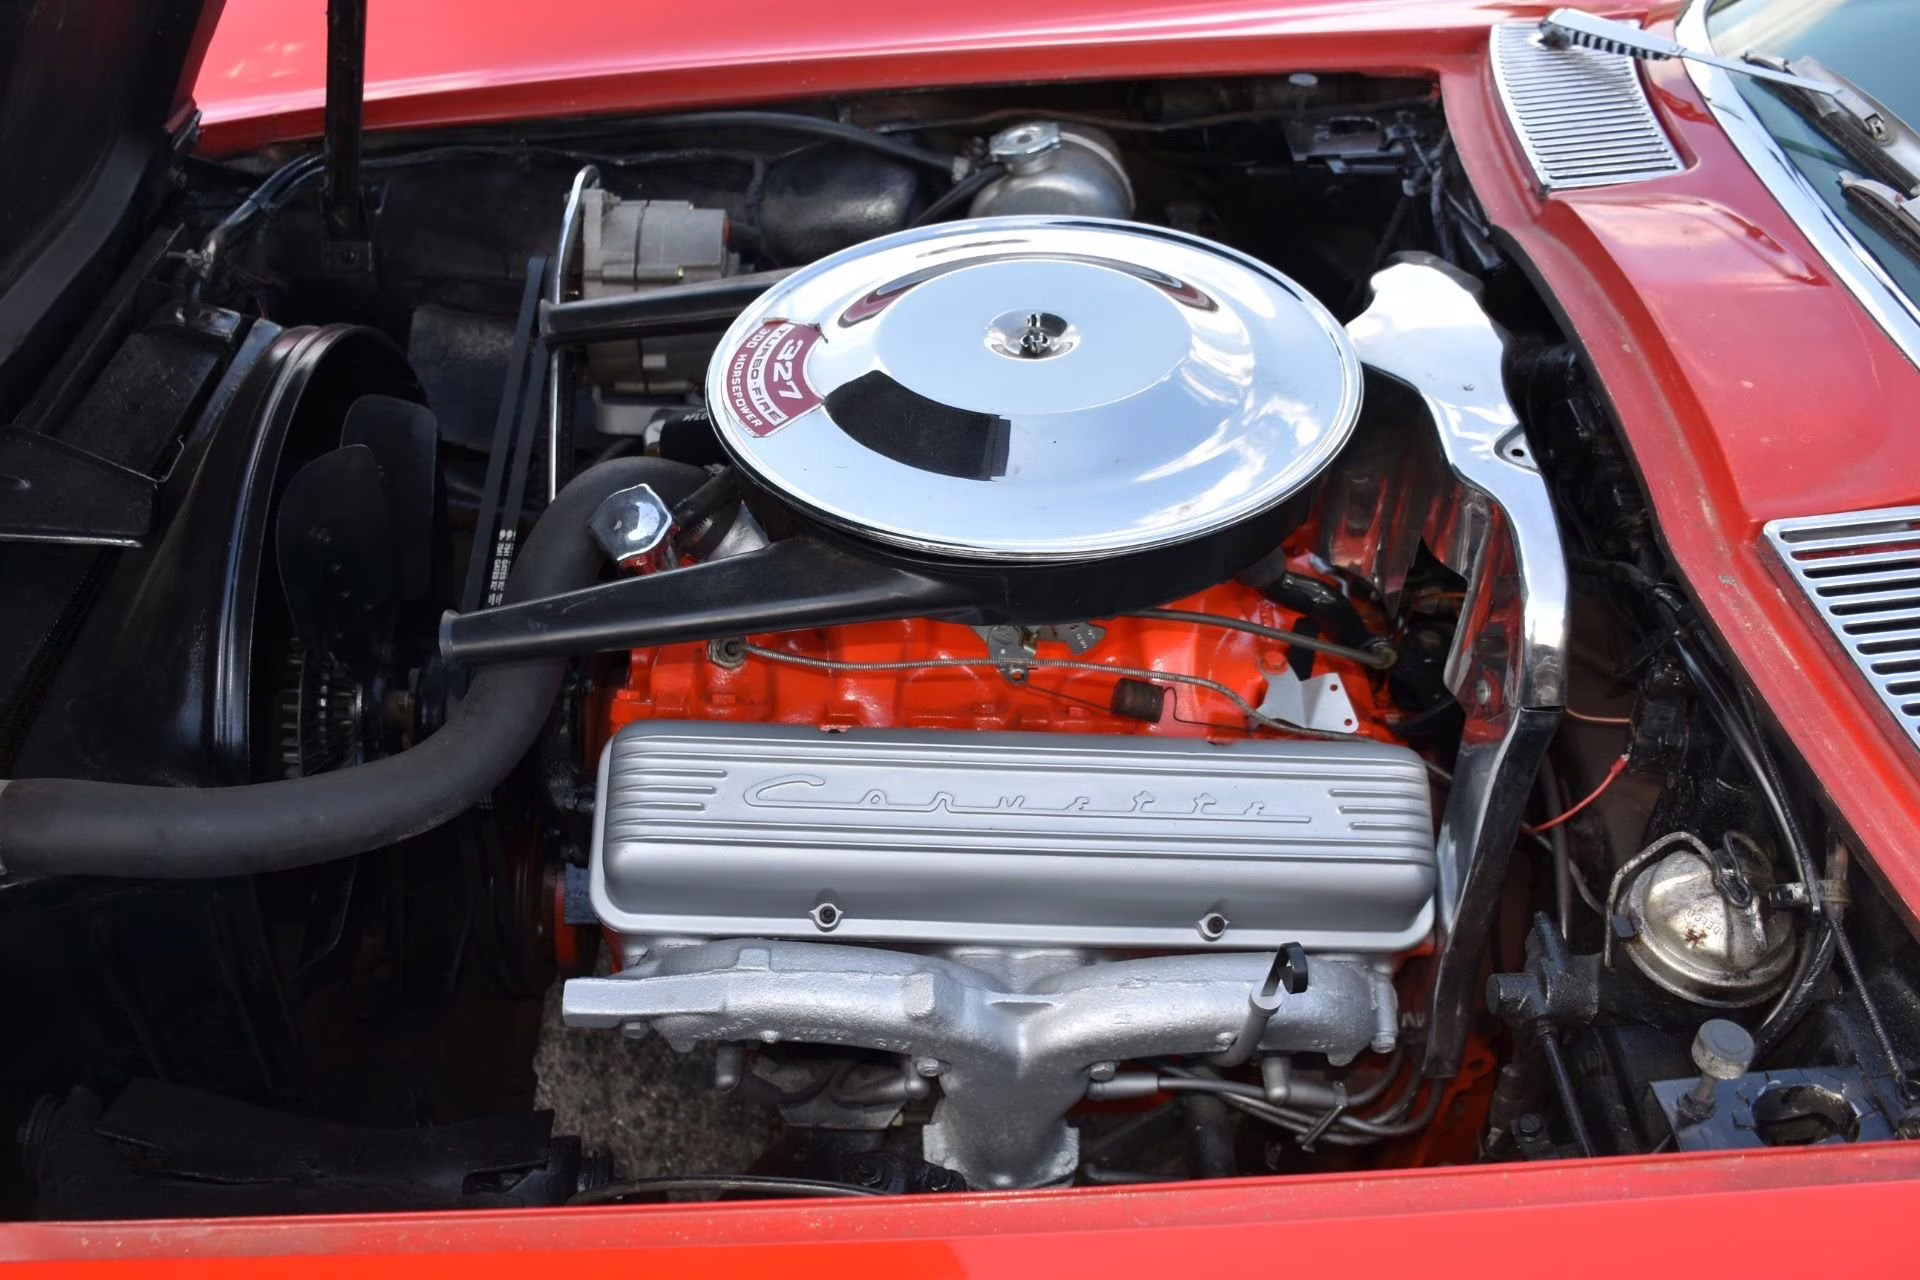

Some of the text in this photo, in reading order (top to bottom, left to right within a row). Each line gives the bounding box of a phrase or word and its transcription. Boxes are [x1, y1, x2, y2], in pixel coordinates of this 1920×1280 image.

[746, 328, 771, 349] 300
[731, 354, 763, 428] HORSEPOWER
[750, 326, 786, 422] TURBO-FIRE
[773, 339, 804, 400] 327
[743, 773, 1312, 824] Corvette
[1687, 909, 1721, 935] DELCO
